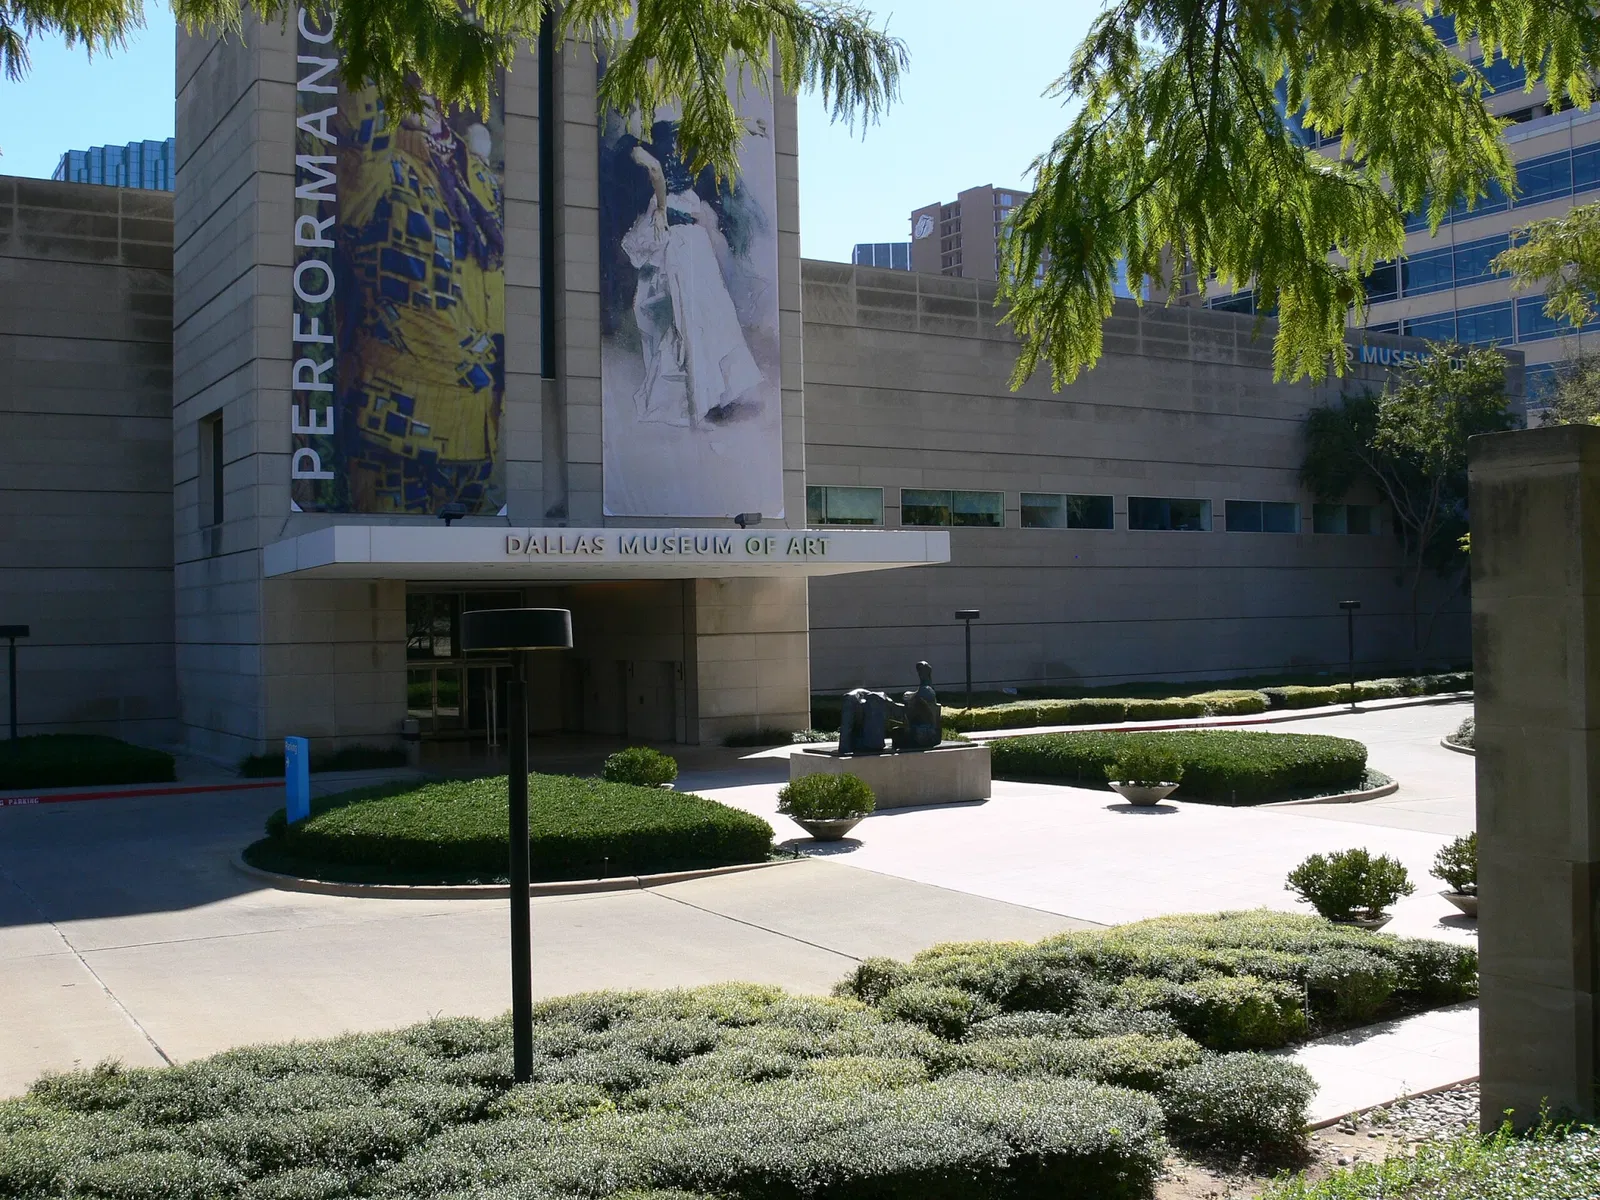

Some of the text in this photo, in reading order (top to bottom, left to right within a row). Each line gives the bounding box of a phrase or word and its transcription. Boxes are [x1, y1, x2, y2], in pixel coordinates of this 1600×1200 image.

[505, 535, 832, 556] DALLAS MUSEUM OF ART
[8, 797, 40, 805] PARKING
